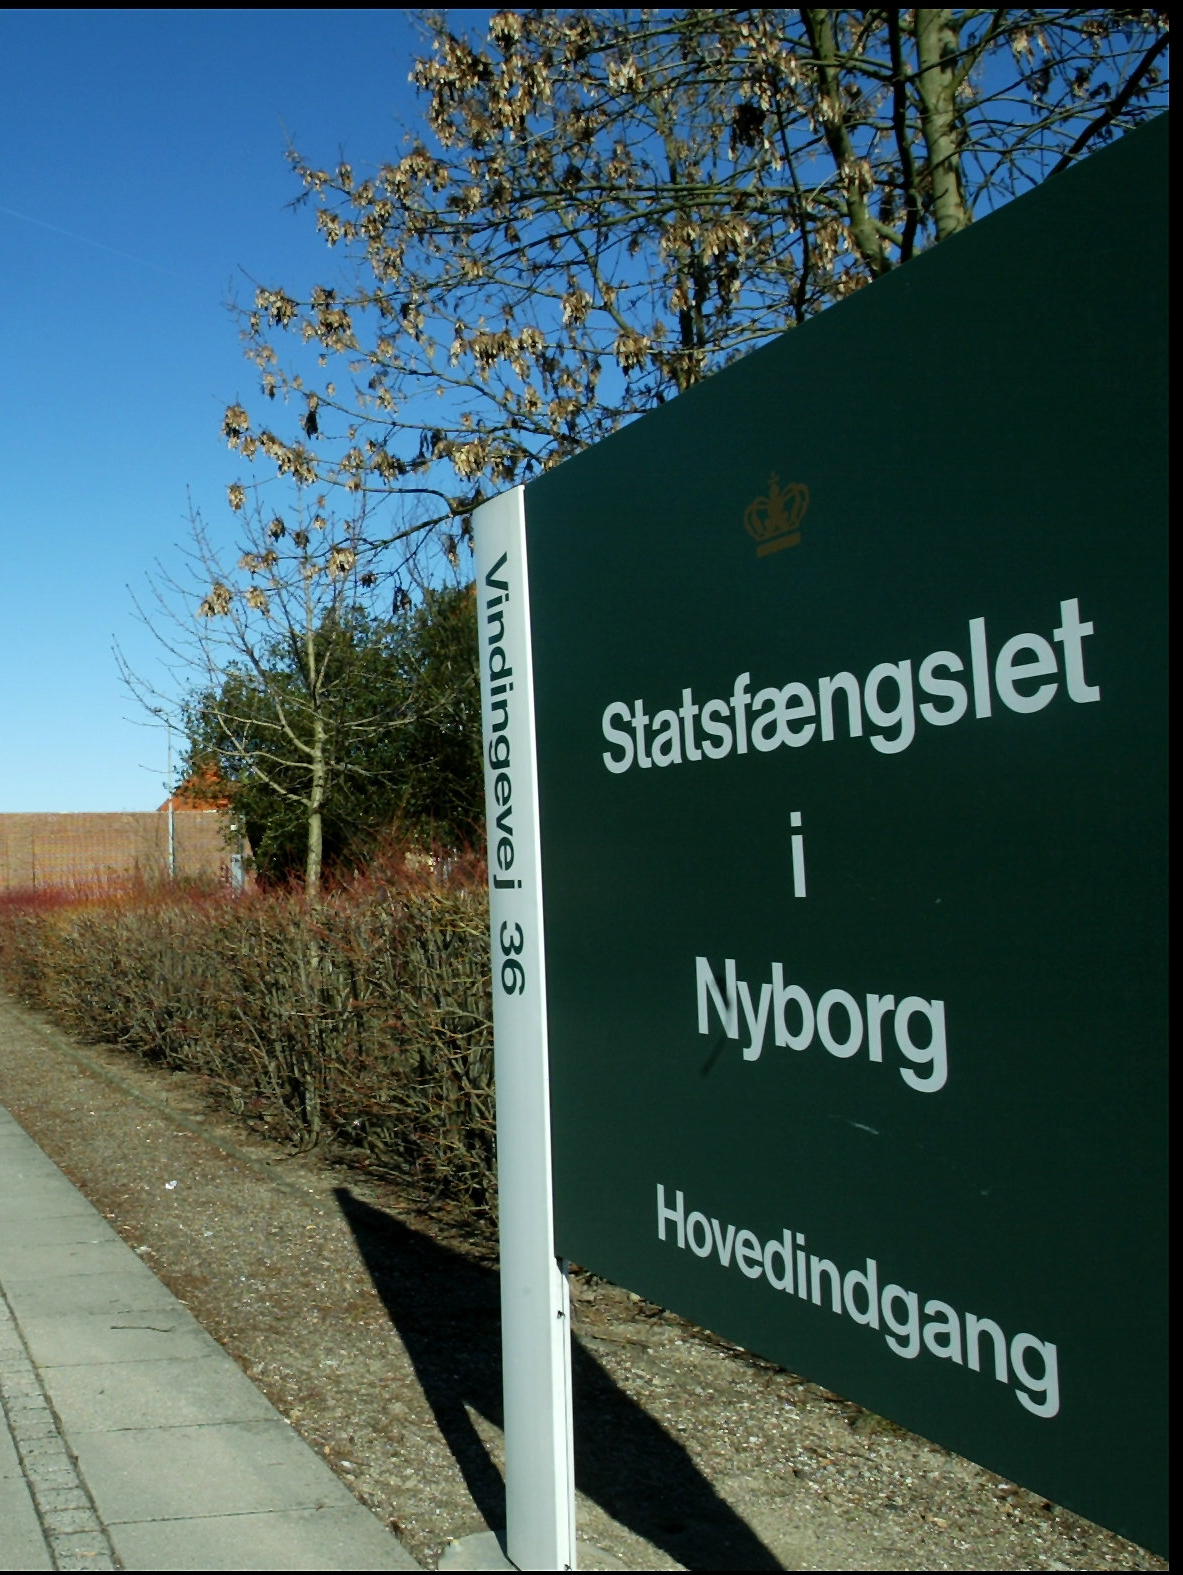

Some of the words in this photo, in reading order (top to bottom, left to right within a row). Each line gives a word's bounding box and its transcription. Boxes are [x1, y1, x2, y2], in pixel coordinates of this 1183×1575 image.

[484, 551, 523, 891] Vindingevej
[601, 597, 1101, 774] Statsfængslet
[790, 811, 808, 898] i
[499, 920, 526, 996] 36
[695, 956, 948, 1094] Nyborg
[656, 1183, 1060, 1418] Hovedindgang
